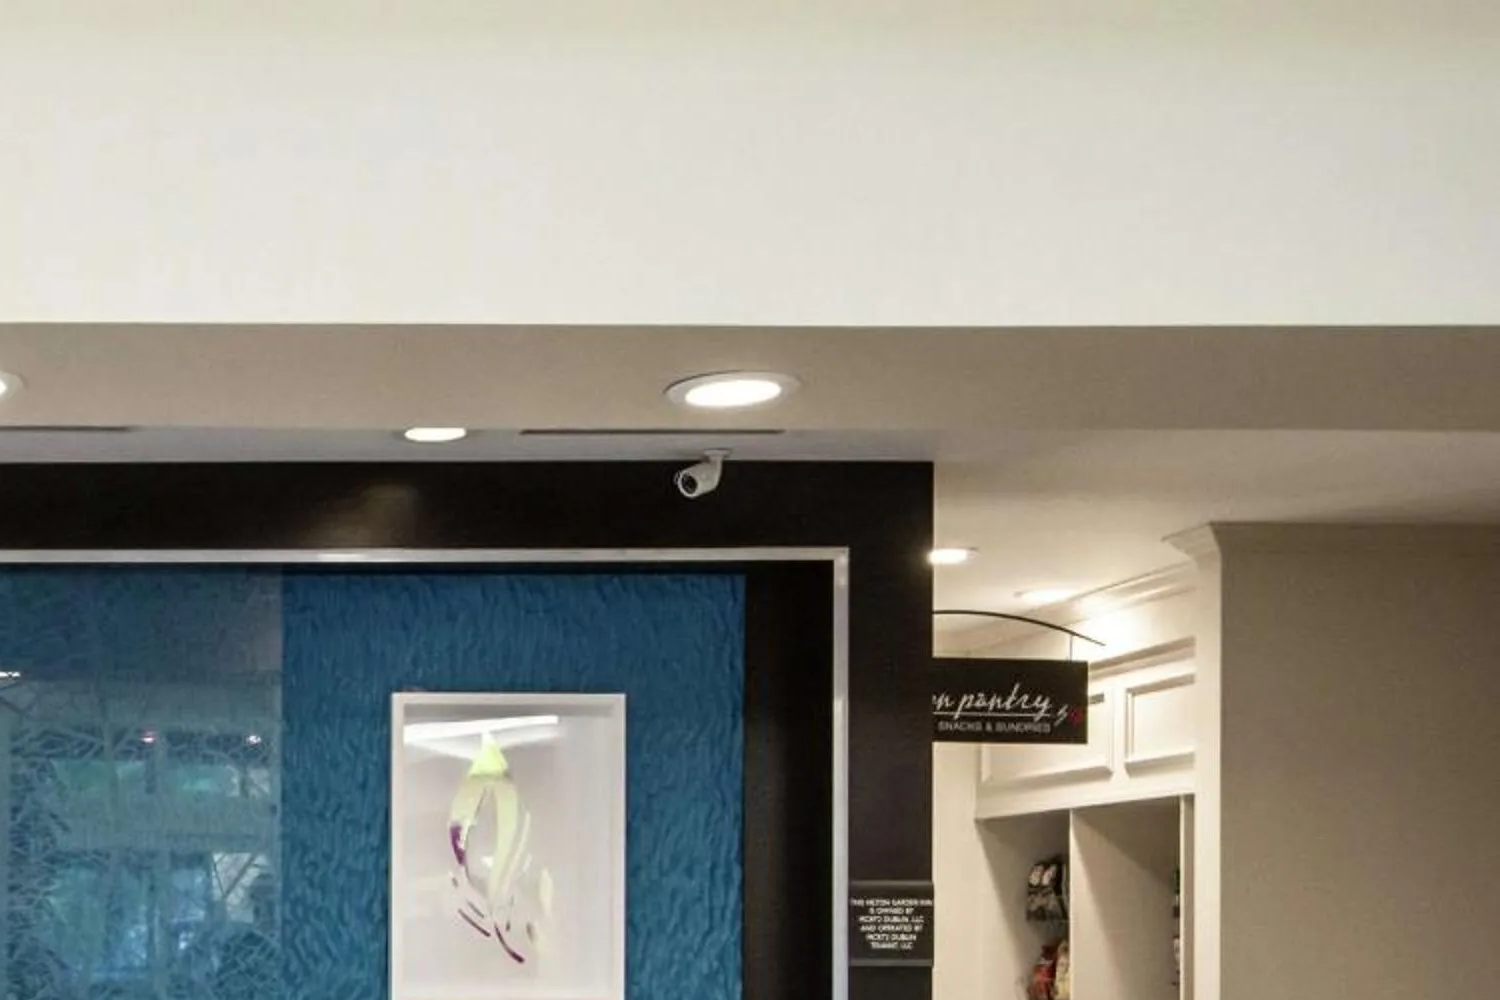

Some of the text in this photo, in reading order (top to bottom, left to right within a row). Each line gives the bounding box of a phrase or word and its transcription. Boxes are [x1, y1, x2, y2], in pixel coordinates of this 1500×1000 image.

[937, 721, 982, 732] SNACKS
[984, 721, 993, 732] &
[865, 898, 890, 906] HILTON
[891, 898, 918, 906] GARDEN
[860, 924, 877, 932] AND
